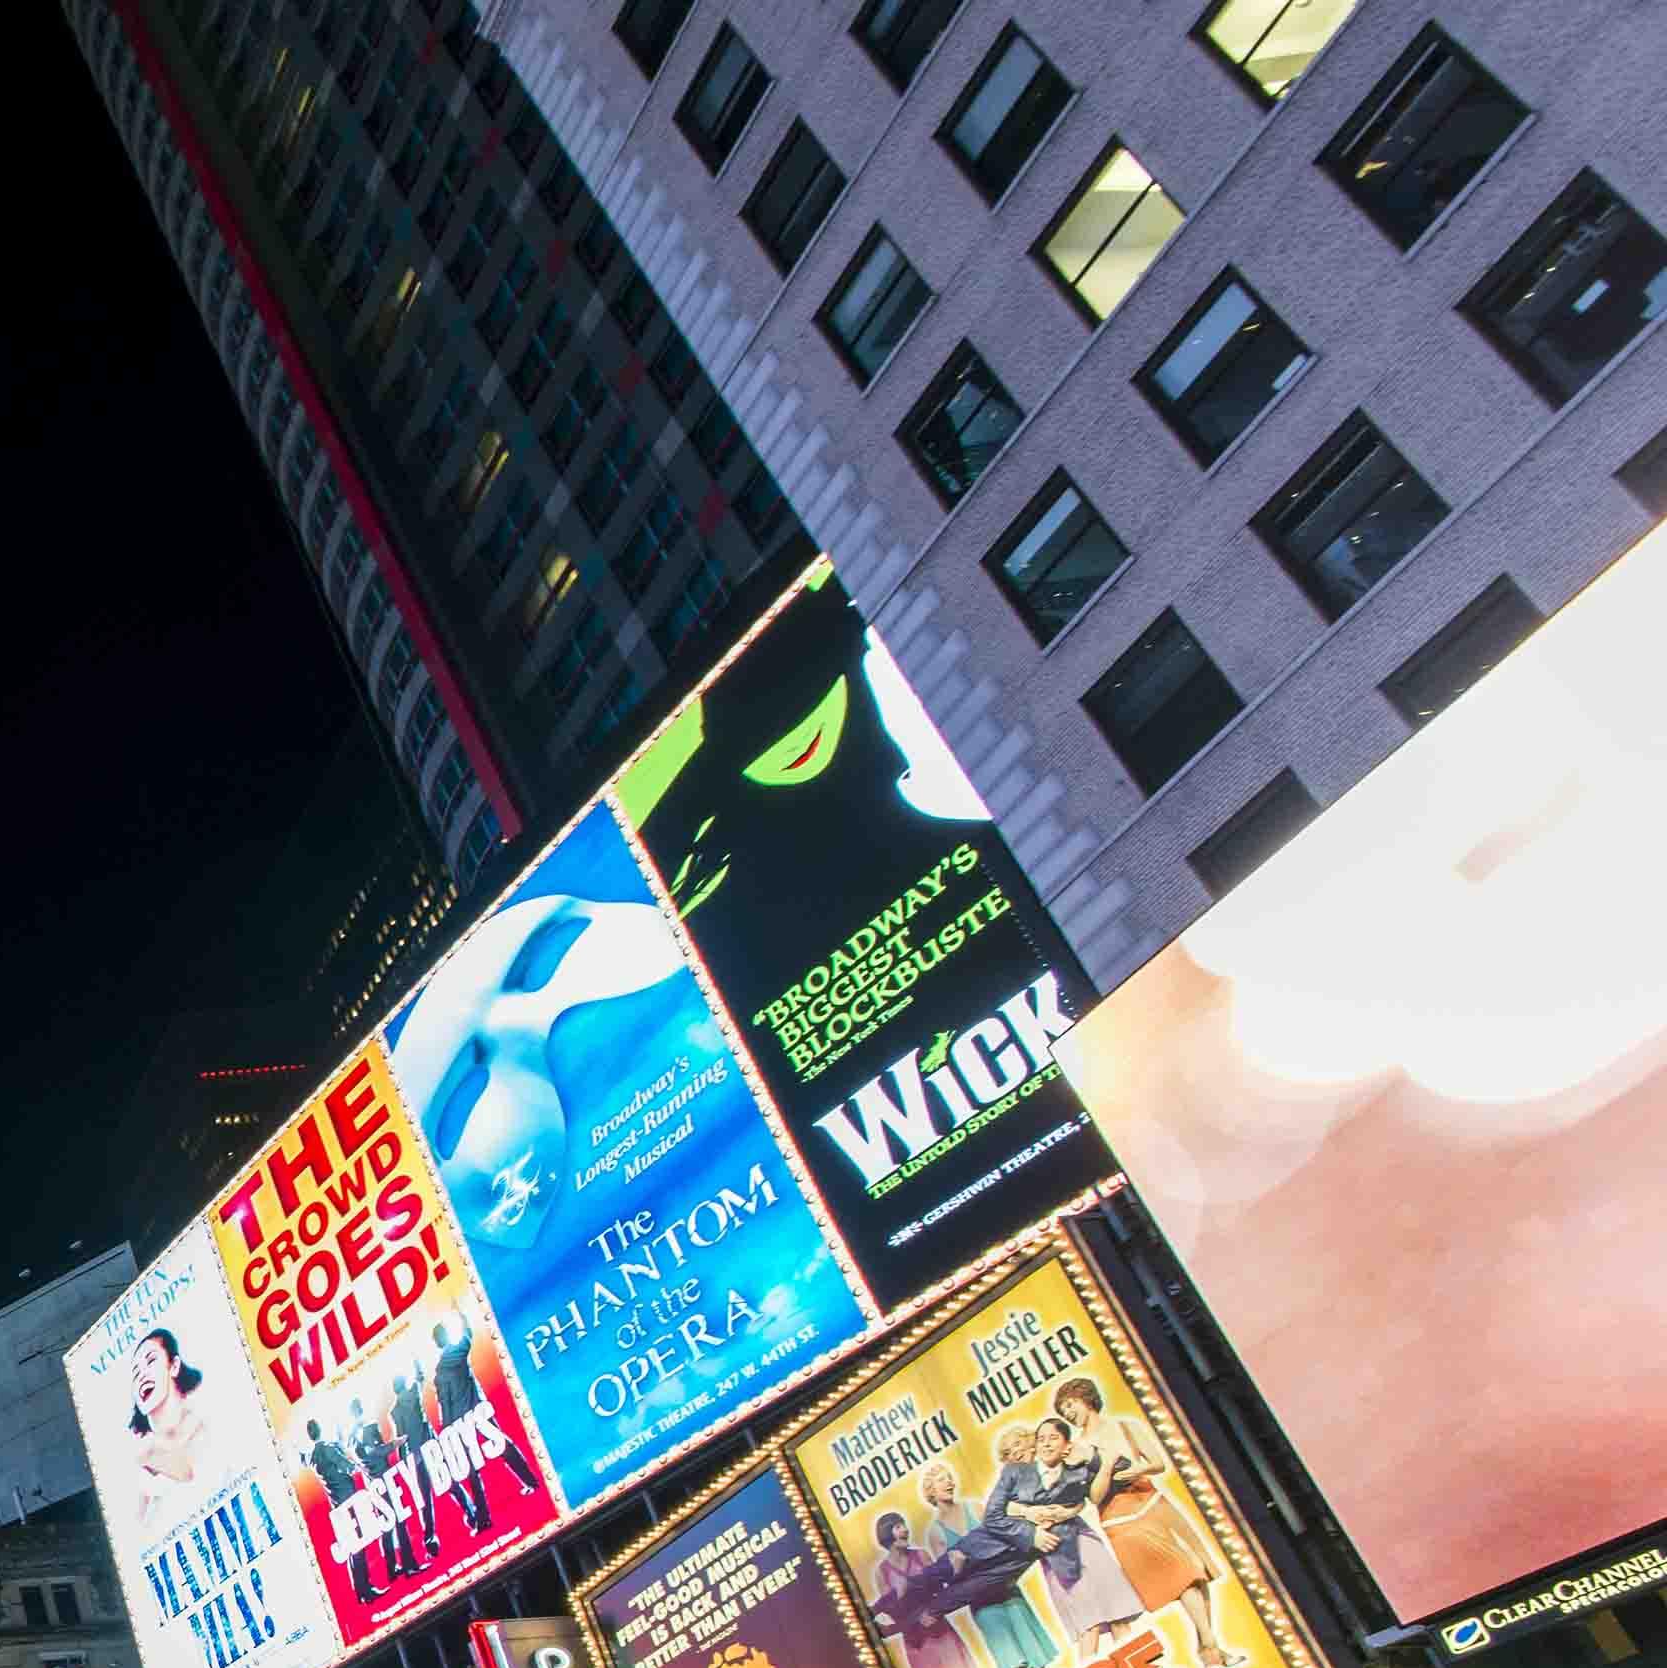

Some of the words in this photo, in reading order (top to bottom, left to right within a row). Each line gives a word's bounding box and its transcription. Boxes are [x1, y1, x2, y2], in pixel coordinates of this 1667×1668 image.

[775, 929, 912, 1051] BIGGEST
[574, 1058, 729, 1192] Longest-Running
[590, 1056, 691, 1147] Broadway's
[624, 1115, 695, 1184] Musical
[870, 1176, 903, 1201] THE
[901, 1130, 967, 1179] UNTOLD
[966, 1090, 1020, 1133] STORY
[1018, 1076, 1045, 1096] OF
[243, 1131, 403, 1299] CROWD
[588, 1208, 656, 1263] The
[923, 1169, 1003, 1225] GERSHWIN
[256, 1175, 423, 1350] GOES
[524, 1161, 779, 1372] PHANTOM
[616, 1297, 644, 1350] of
[651, 1276, 700, 1325] the
[587, 1287, 764, 1418] OPERA
[965, 1324, 1091, 1426] MUELLER
[968, 1305, 1045, 1377] Jessie
[329, 1451, 425, 1564] JERSEY
[420, 1401, 506, 1497] BOYS
[827, 1407, 962, 1520] BRODERICK
[829, 1391, 920, 1469] Matthew
[145, 1481, 283, 1628] MAMMA
[617, 1577, 704, 1647] FEEL-GOOD
[707, 1521, 787, 1585] MUSICAL
[651, 1625, 668, 1646] IS
[670, 1591, 716, 1633] BACK
[719, 1564, 759, 1601] AND
[666, 1521, 747, 1587] ULTIMATE
[690, 1600, 742, 1642] THAN
